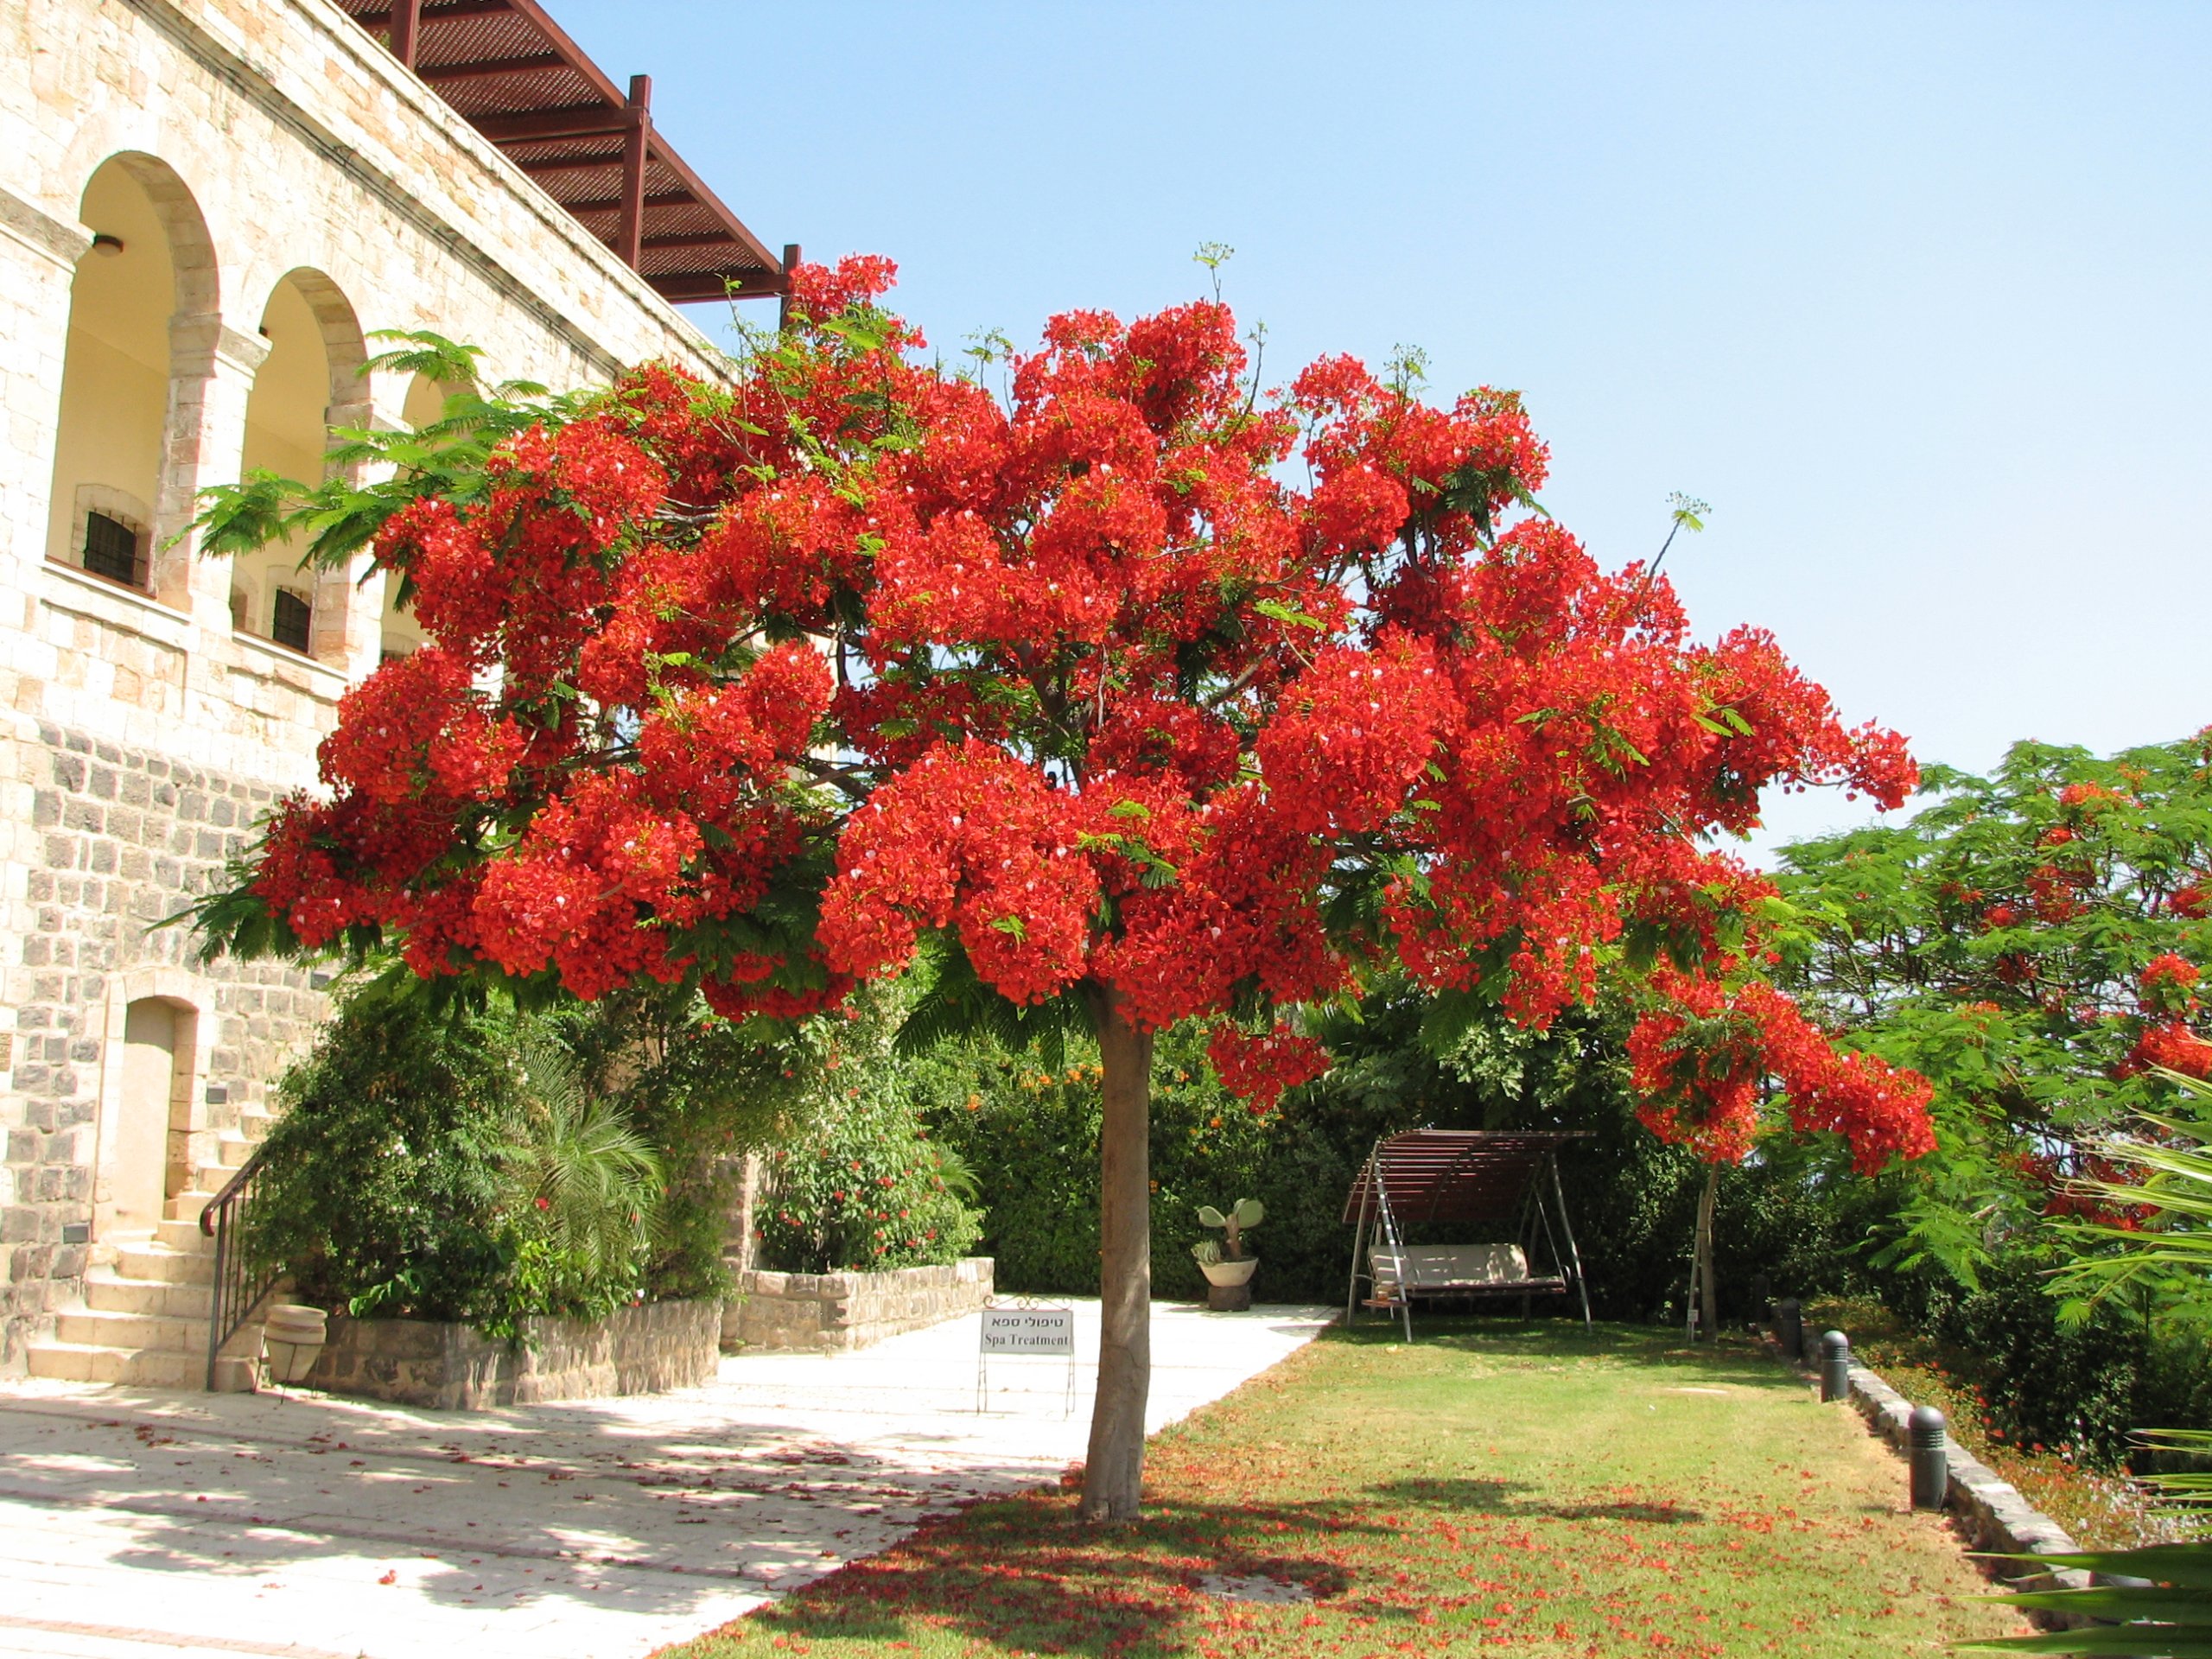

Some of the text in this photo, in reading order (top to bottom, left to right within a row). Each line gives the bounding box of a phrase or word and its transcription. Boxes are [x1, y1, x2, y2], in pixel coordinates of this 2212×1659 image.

[992, 1317, 1064, 1327] טיפולי ספא
[985, 1333, 1068, 1347] Spa Treatment
